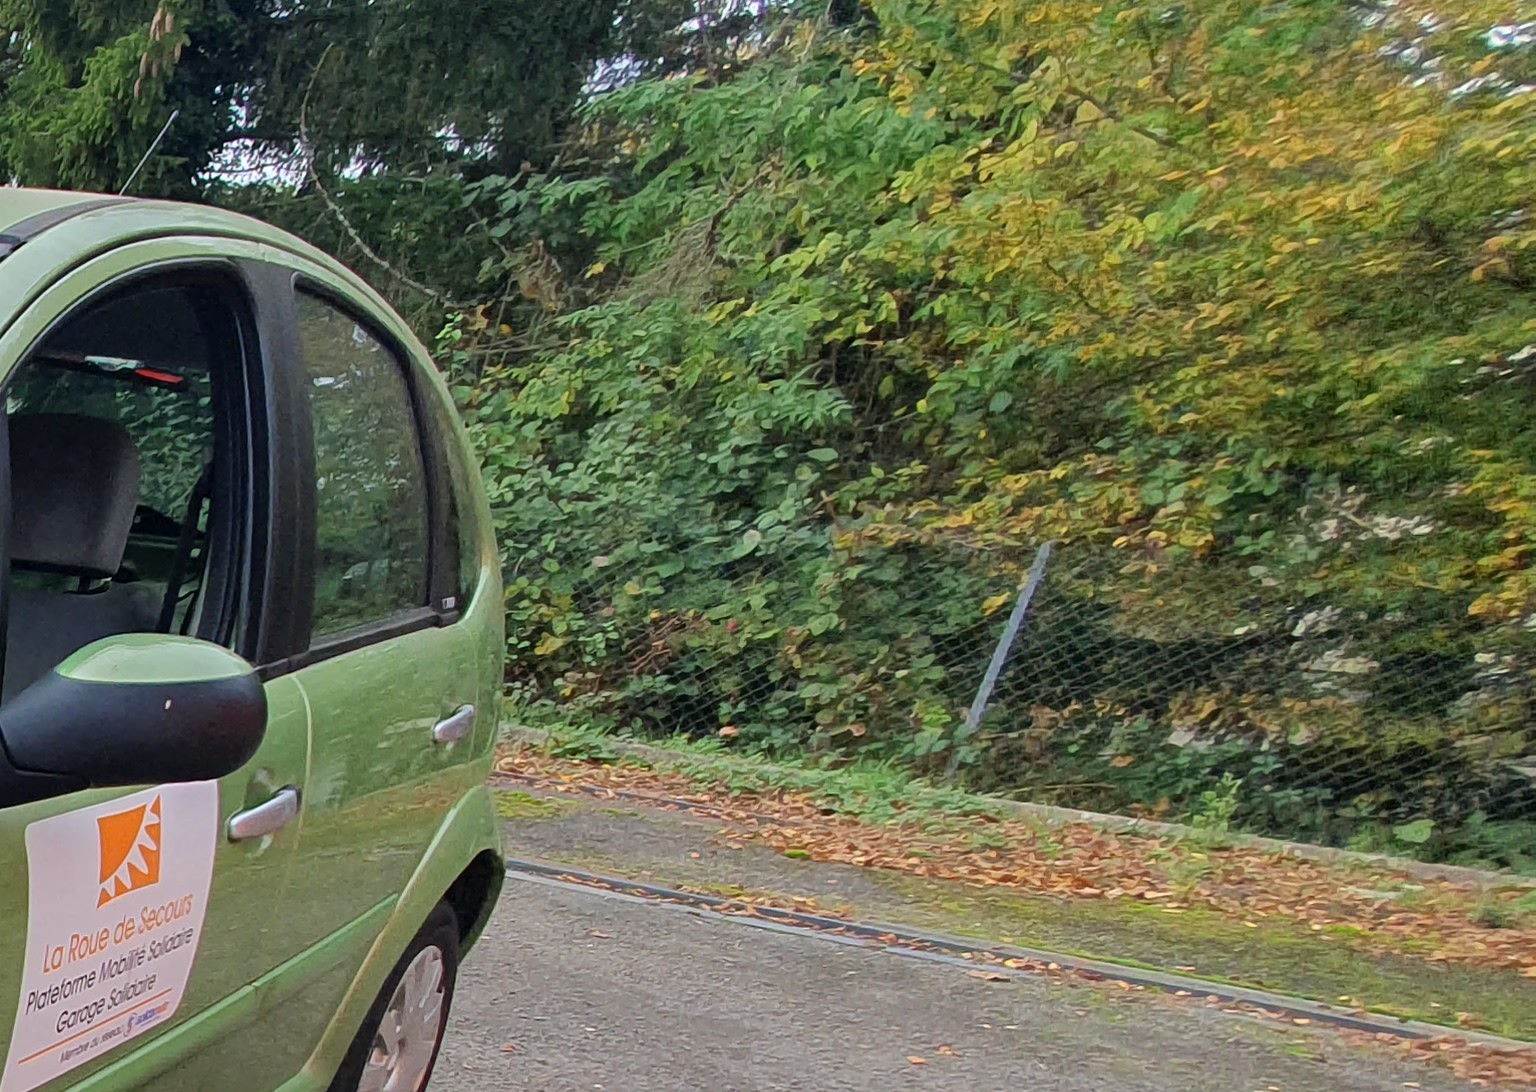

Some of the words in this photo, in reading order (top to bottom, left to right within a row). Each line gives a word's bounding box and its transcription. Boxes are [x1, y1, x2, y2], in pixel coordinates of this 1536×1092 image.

[26, 971, 96, 1015] Plateforme
[99, 943, 147, 983] Mobilité
[147, 927, 193, 962] Solidaire
[43, 943, 64, 973] La
[68, 927, 110, 963] Roue
[113, 915, 135, 944] de
[138, 894, 193, 934] Secours
[56, 997, 105, 1034] Garage
[107, 974, 157, 1010] Solidaire
